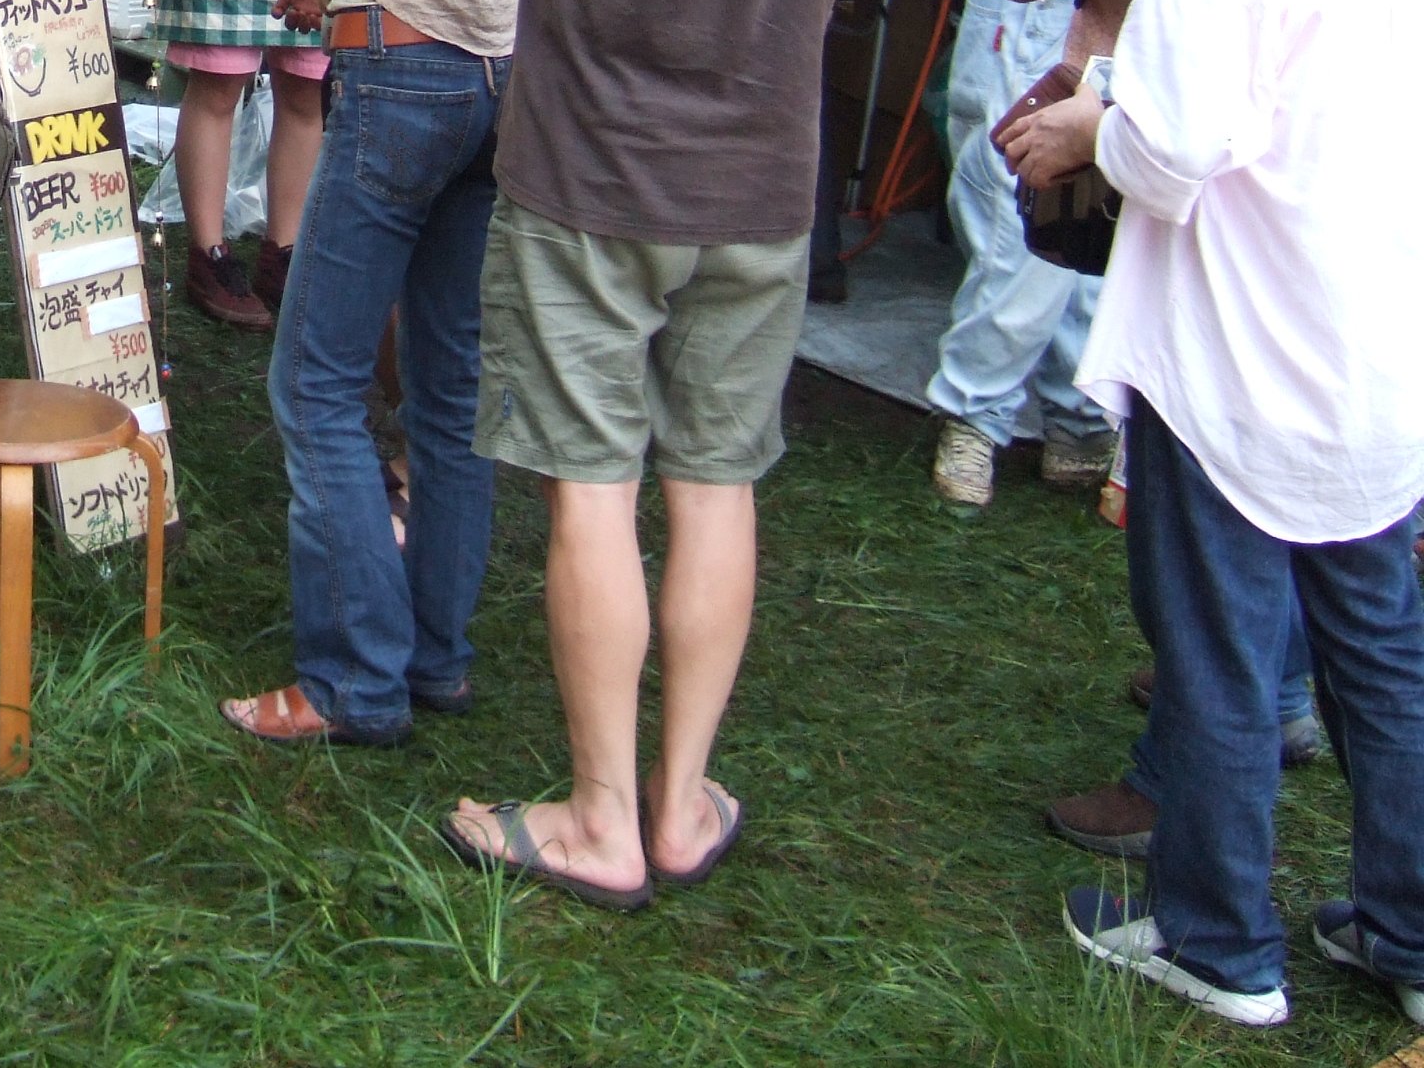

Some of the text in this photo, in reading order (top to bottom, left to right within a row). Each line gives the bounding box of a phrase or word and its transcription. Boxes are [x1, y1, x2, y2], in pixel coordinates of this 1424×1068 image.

[66, 46, 110, 83] ¥600
[26, 111, 109, 165] DRINK
[21, 171, 126, 221] BEER ¥500
[50, 206, 124, 243] スーパードライ
[85, 272, 125, 303] チャイ
[109, 331, 147, 363] ¥500
